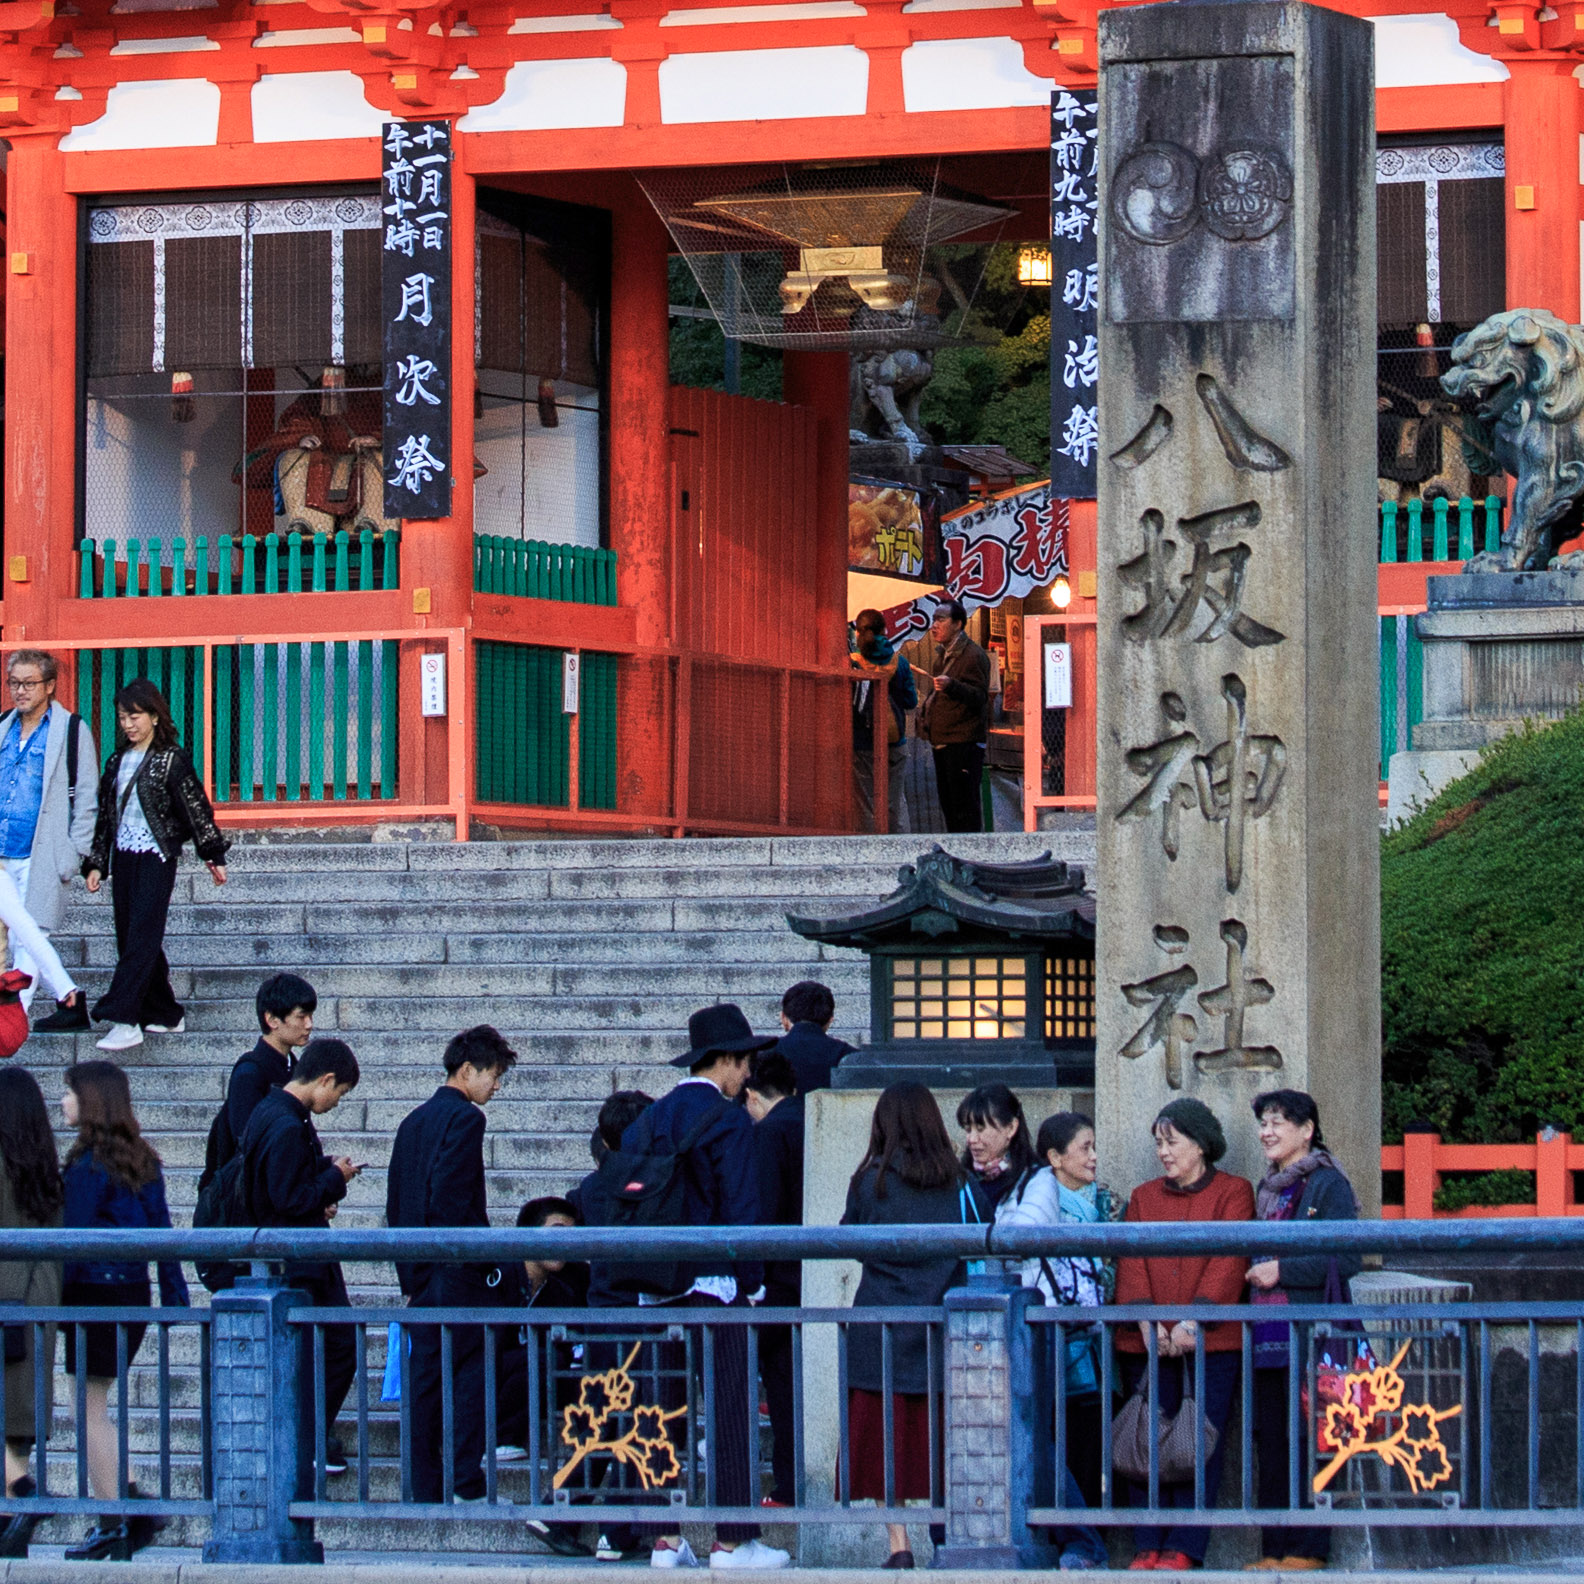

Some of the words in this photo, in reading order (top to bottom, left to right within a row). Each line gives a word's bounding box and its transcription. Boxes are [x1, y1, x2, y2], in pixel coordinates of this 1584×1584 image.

[382, 123, 421, 257] 午前十時
[412, 124, 448, 250] 十一月一日
[1051, 91, 1091, 243] 午前九時
[388, 272, 446, 495] 月次祭
[875, 525, 924, 573] ポテト
[1109, 372, 1293, 1091] 八坂神社
